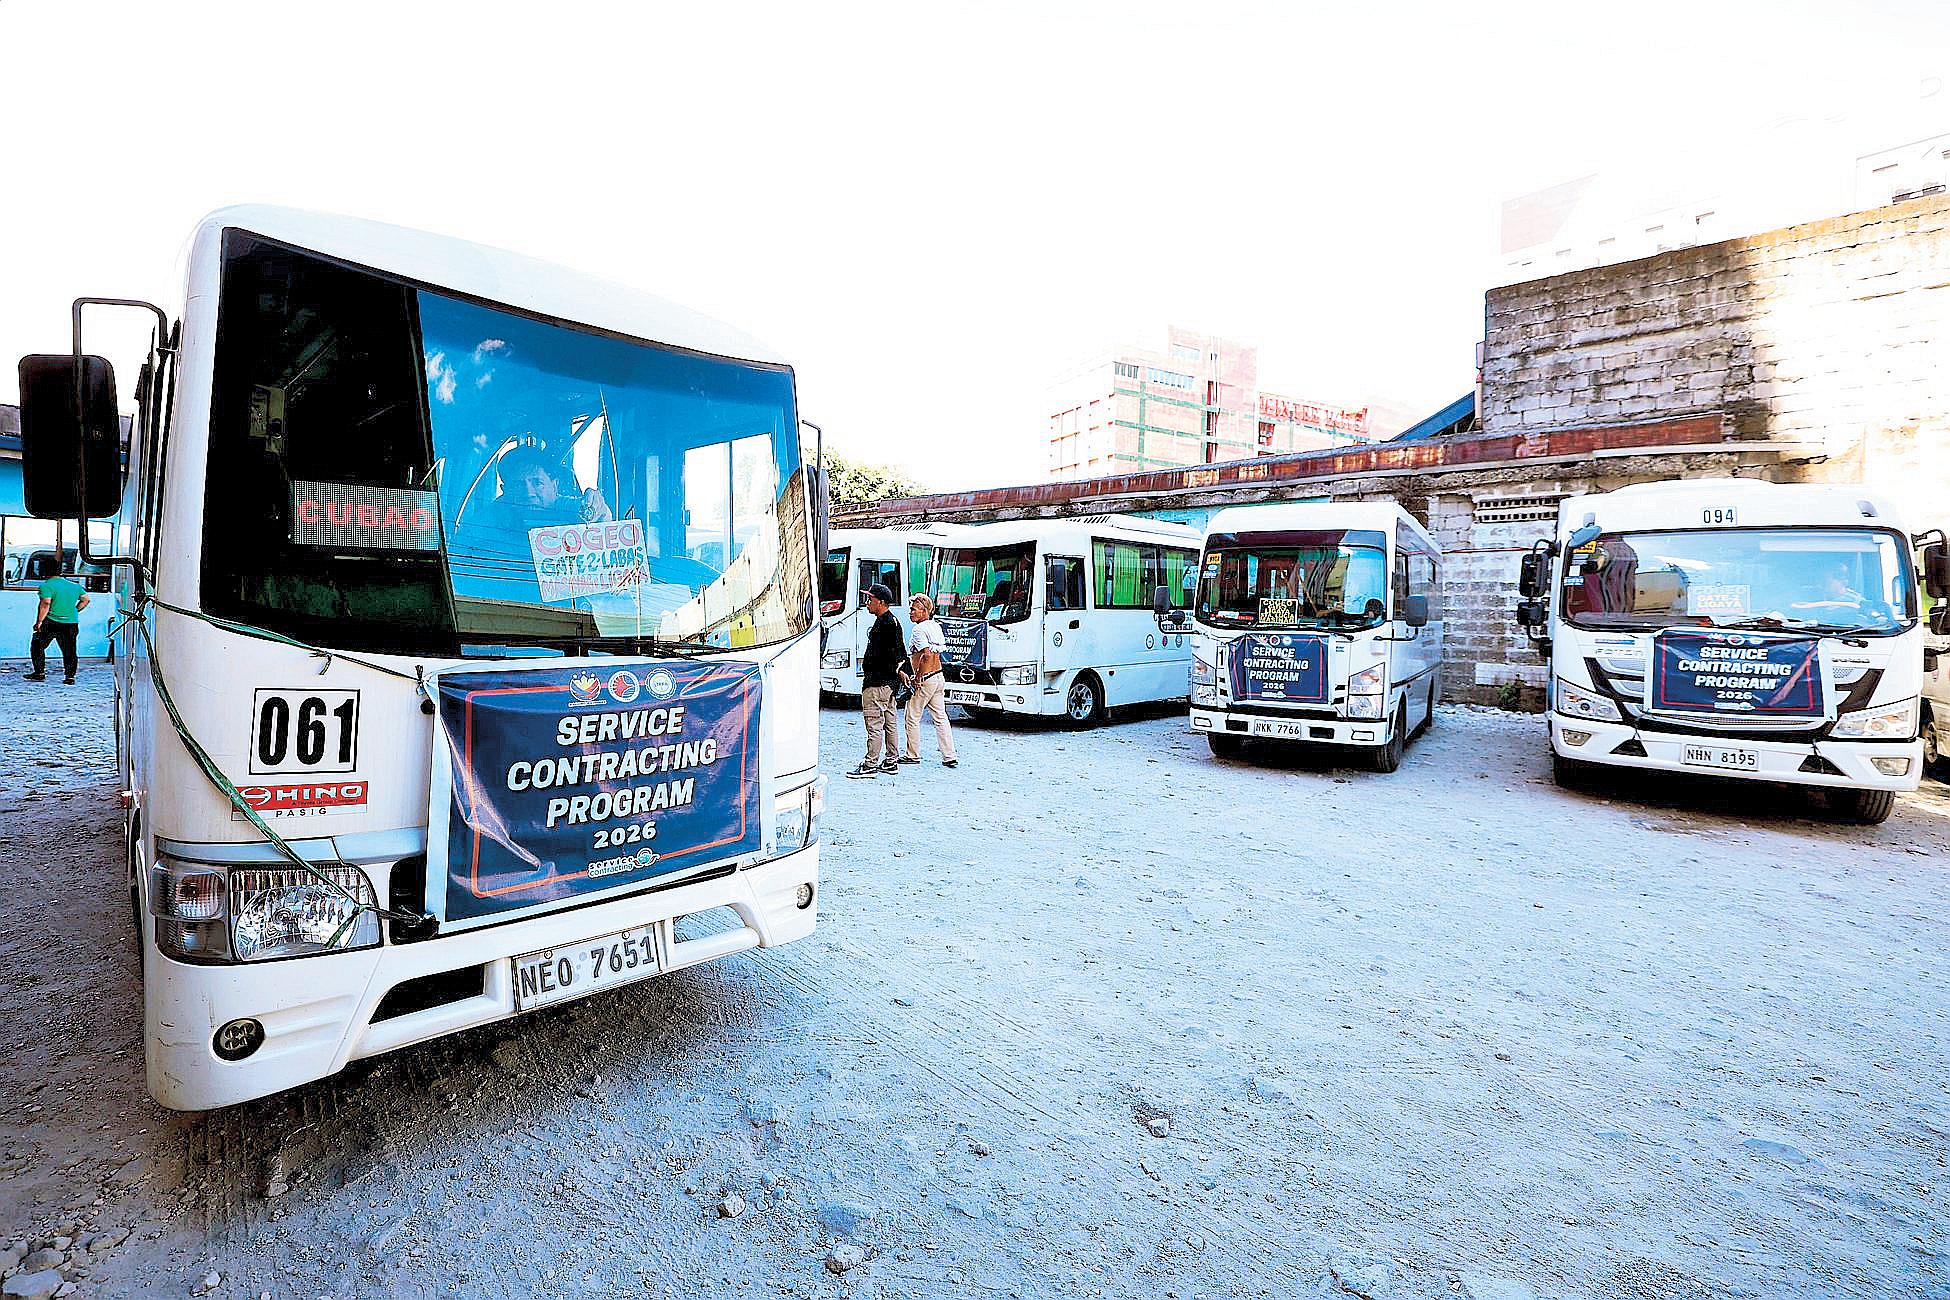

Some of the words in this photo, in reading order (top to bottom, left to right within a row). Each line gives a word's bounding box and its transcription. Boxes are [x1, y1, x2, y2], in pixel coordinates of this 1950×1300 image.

[298, 500, 432, 530] CUBAO
[1703, 509, 1734, 523] 094
[534, 523, 640, 556] COGEO
[541, 555, 585, 576] GATE
[1252, 646, 1296, 658] SERVICE
[1700, 646, 1769, 660] SERVICE
[1249, 669, 1299, 682] PROGRAM
[1678, 659, 1792, 677] CONTRACTING
[1262, 682, 1285, 690] 2026
[1694, 674, 1776, 690] PROGRAM
[1716, 690, 1753, 700] 2026
[258, 696, 355, 766] 061
[556, 706, 686, 747] SERVICE
[1277, 725, 1300, 735] 7766
[507, 738, 718, 792] CONTRACTING
[1687, 749, 1712, 762] NHN
[1721, 752, 1755, 766] 8195
[276, 785, 363, 801] HINO
[545, 777, 695, 829] PROGRAM
[275, 807, 327, 818] PASIG
[593, 821, 657, 849] 2026
[589, 863, 633, 877] contracting
[520, 957, 573, 998] NEO
[590, 935, 655, 979] 7651
